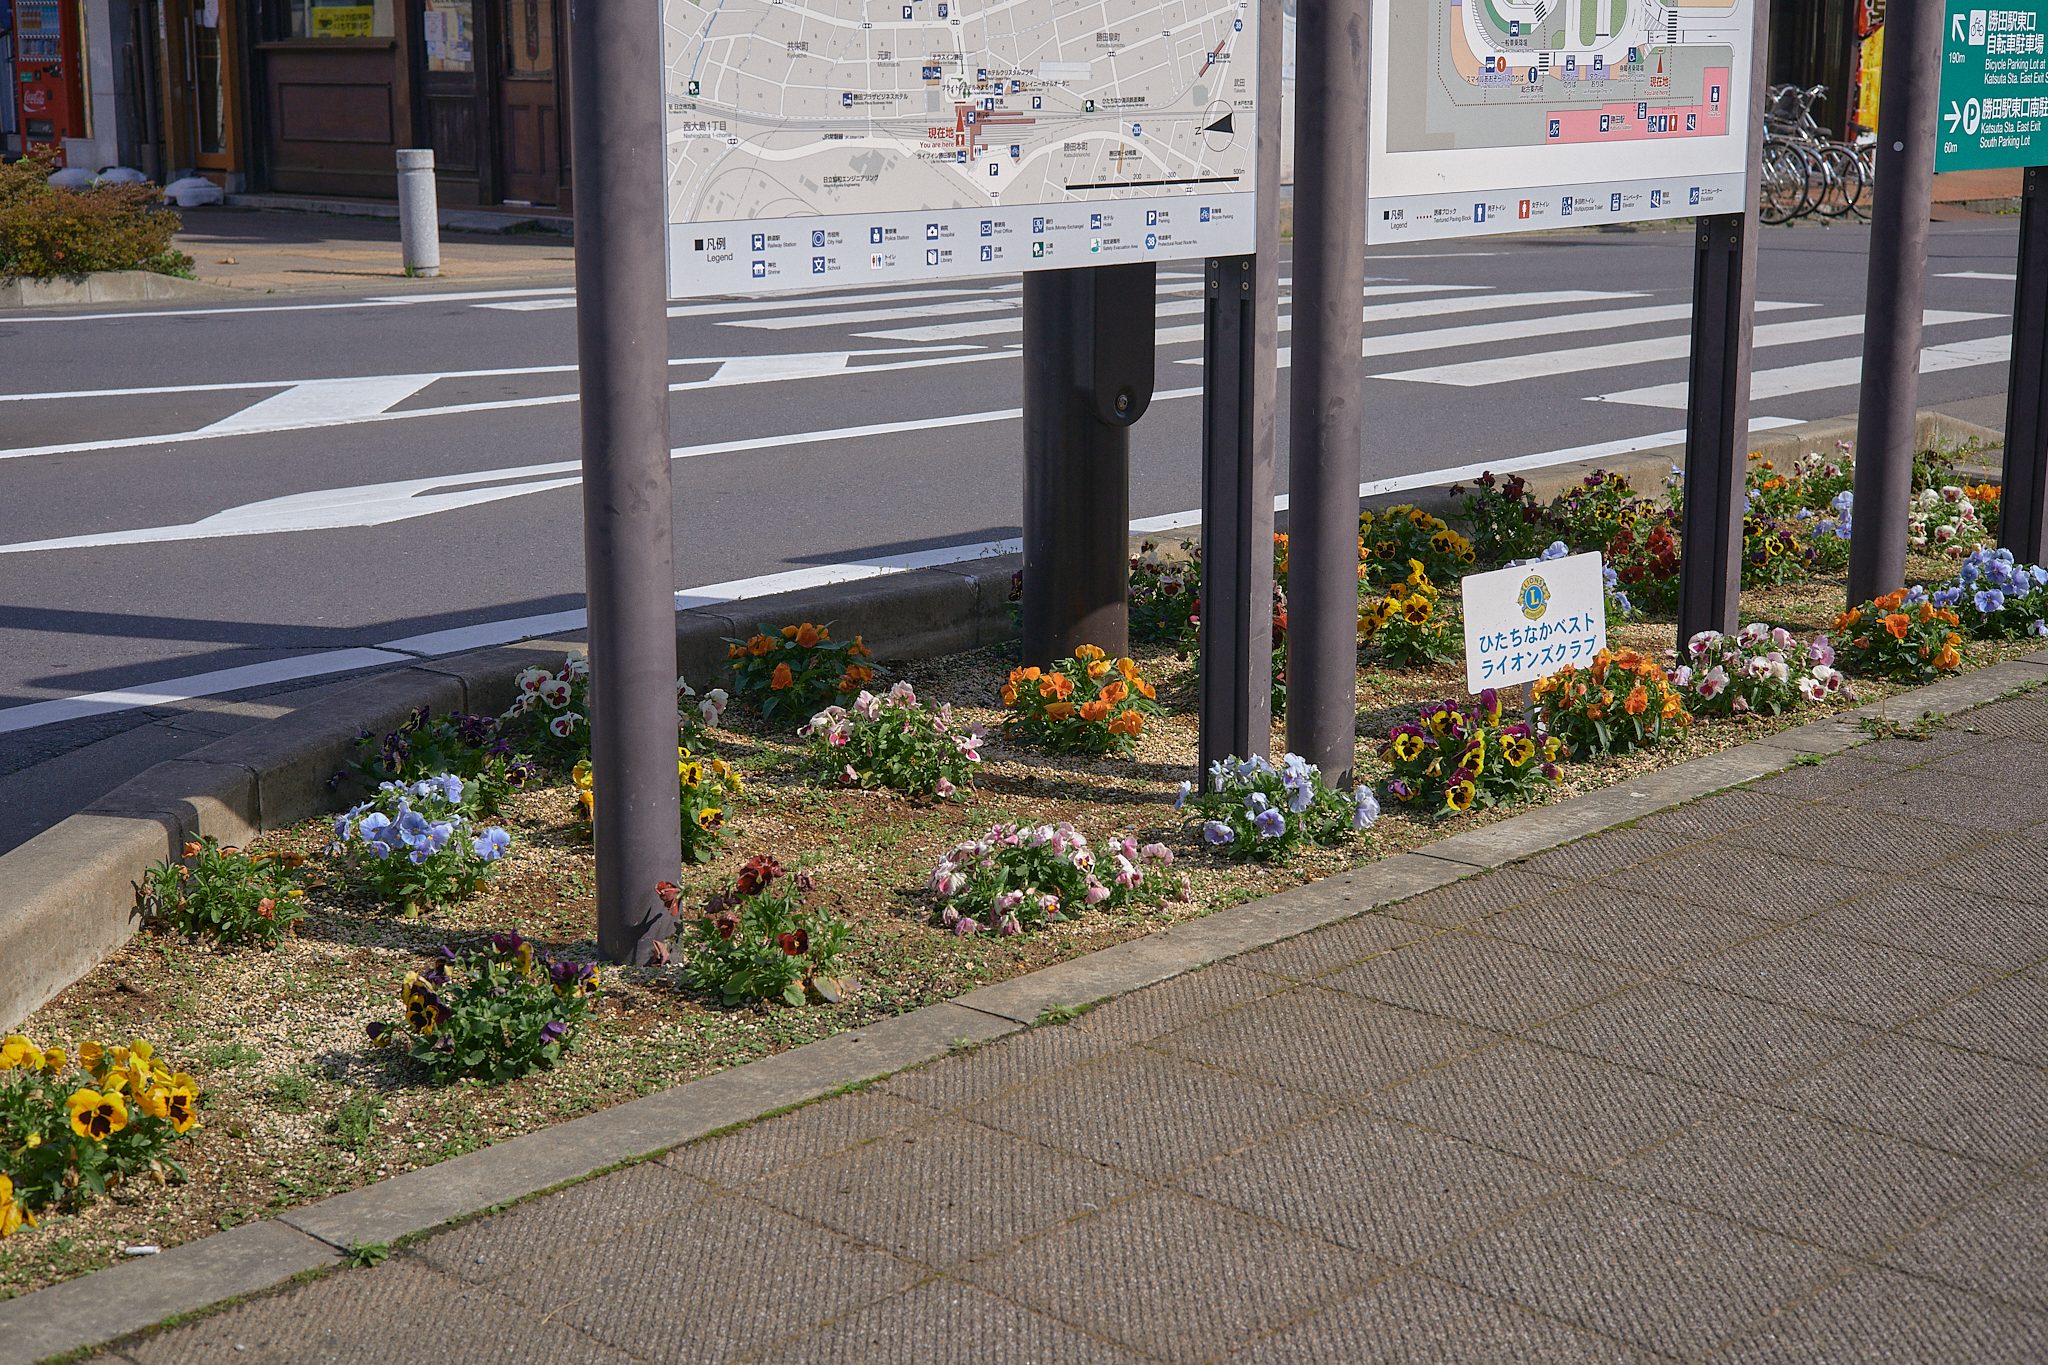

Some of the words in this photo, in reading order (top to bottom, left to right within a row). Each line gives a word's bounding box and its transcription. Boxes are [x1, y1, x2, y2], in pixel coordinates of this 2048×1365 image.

[1987, 10, 2036, 31] 勝田駅東口
[787, 42, 808, 51] 共栄町
[1987, 33, 2044, 55] 自転車駐車場
[878, 51, 892, 60] 元町
[1949, 52, 1965, 63] 190m
[1985, 59, 2006, 72] Bicycle
[2007, 59, 2029, 72] Parking
[2029, 59, 2039, 70] Lot
[2040, 60, 2046, 69] at
[1650, 77, 1668, 87] 現在地
[1984, 73, 2006, 84] Katsuta
[2007, 73, 2018, 84] Sta.
[2020, 72, 2033, 83] East
[2034, 72, 2044, 83] Exit
[683, 121, 726, 131] 西大島1丁目
[1981, 122, 2003, 134] Katsuta
[2004, 122, 2015, 133] Sta.
[2017, 121, 2029, 132] East
[2030, 121, 2041, 131] Exit
[928, 128, 954, 139] 現在地
[1944, 142, 1957, 153] 60m
[1980, 136, 1997, 148] South
[1998, 136, 2019, 149] Parking
[2021, 135, 2030, 146] Lot
[1391, 210, 1404, 220] 凡例
[1391, 222, 1407, 230] Legend
[706, 237, 726, 250] 凡例
[707, 253, 733, 263] Legend
[1524, 576, 1543, 588] LIONS
[1530, 590, 1539, 605] L
[1479, 613, 1594, 653] ひたちなかベスト
[1481, 635, 1596, 679] ライオンズクラブ
